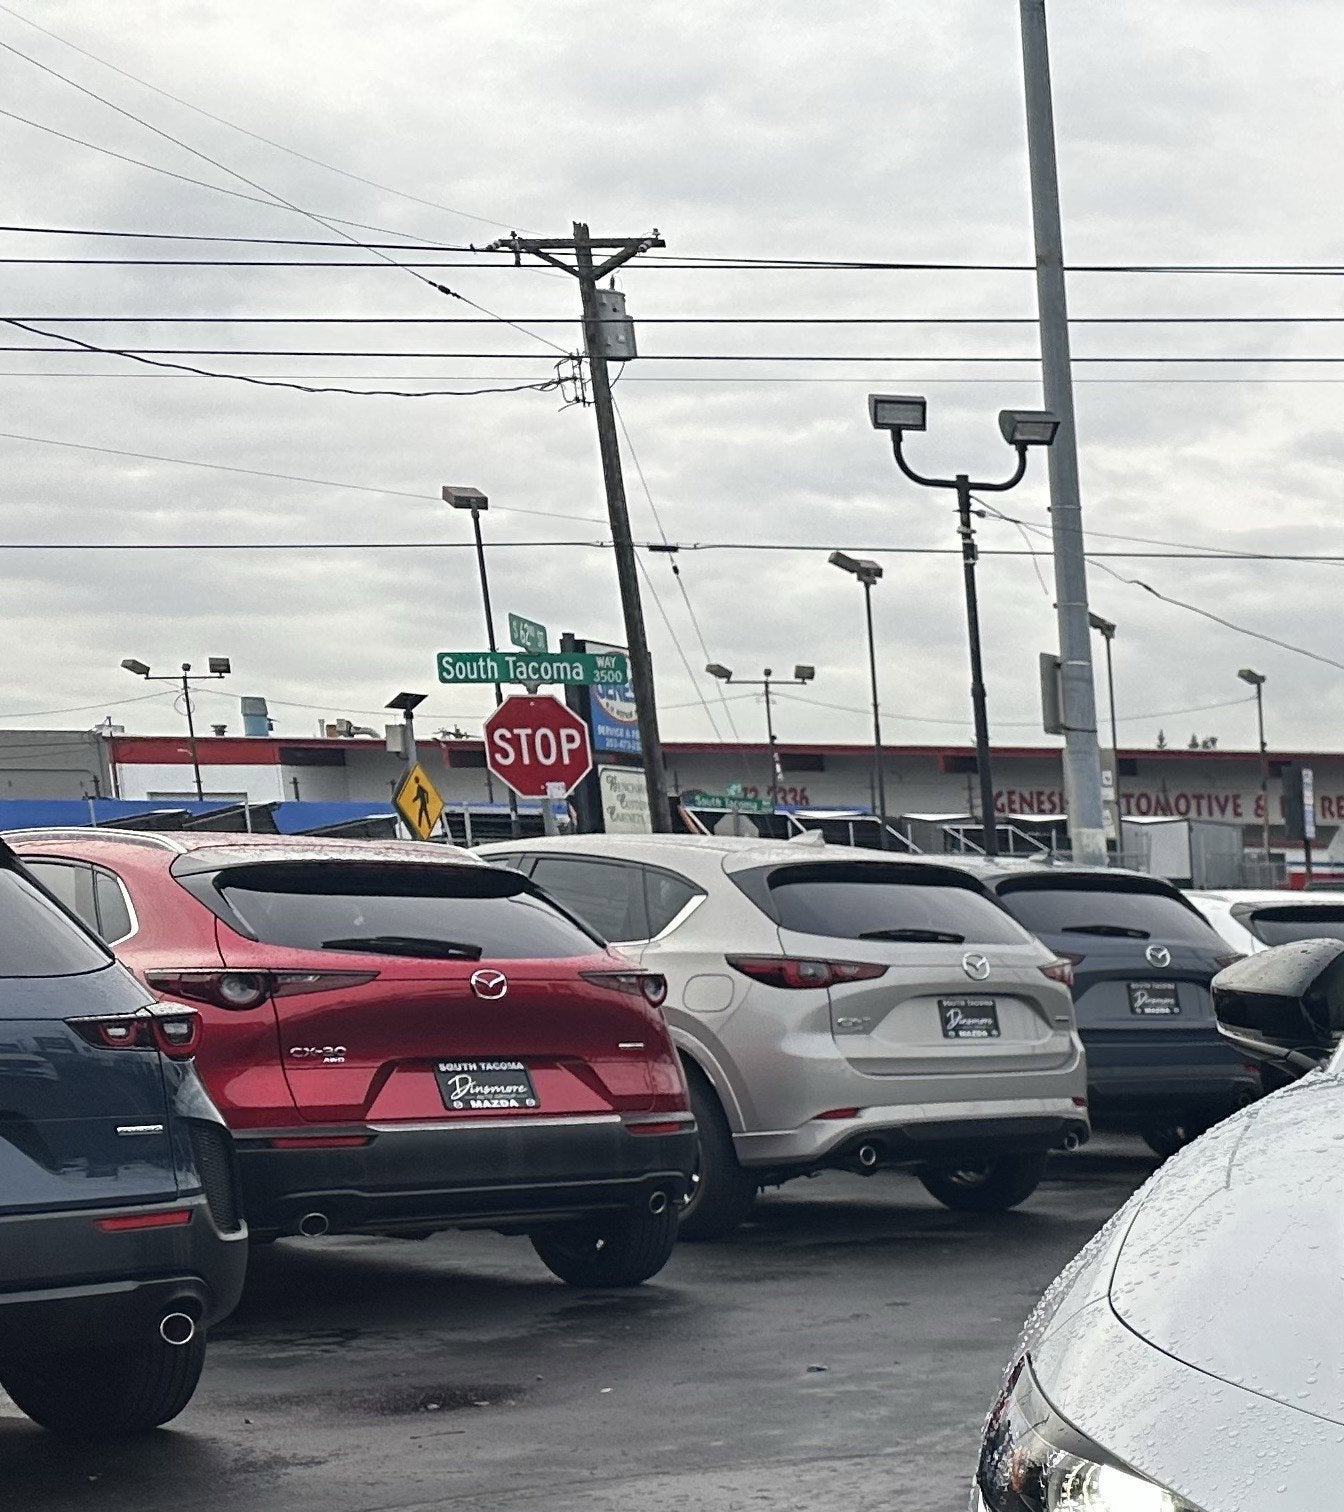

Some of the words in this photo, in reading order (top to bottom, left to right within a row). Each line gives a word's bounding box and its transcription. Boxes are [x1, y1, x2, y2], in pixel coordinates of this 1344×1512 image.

[441, 656, 499, 680] South
[505, 656, 584, 680] Tacoma
[595, 656, 617, 669] WAY
[593, 669, 623, 683] 3500
[493, 727, 581, 765] STOP
[993, 790, 1066, 814] GENESI
[1120, 792, 1244, 817] TOMOTIVE
[290, 1046, 347, 1058] CX-30
[439, 1063, 477, 1071] SOUTH
[479, 1061, 524, 1071] TACOMA
[447, 1074, 527, 1100] Dinsmore
[470, 1099, 519, 1108] MAZDA
